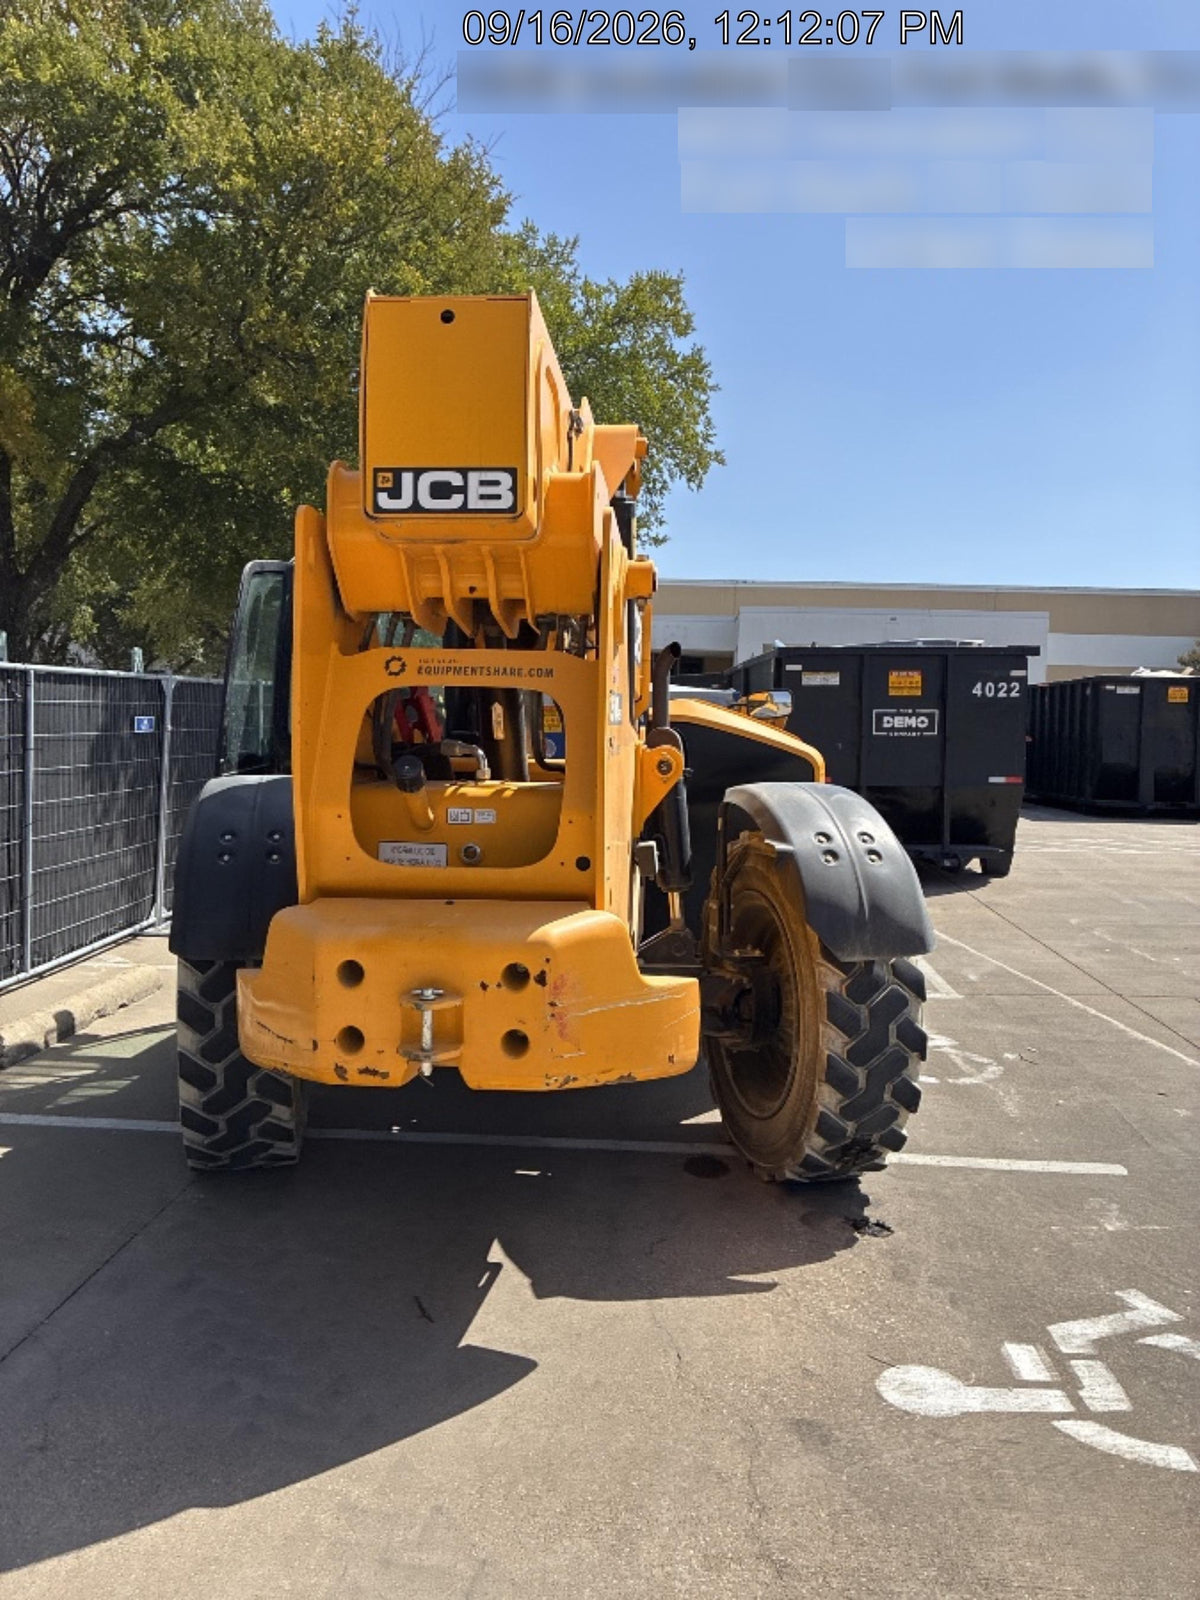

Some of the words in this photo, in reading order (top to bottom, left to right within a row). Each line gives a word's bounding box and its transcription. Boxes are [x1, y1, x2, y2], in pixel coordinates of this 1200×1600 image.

[376, 470, 515, 510] JCB
[417, 664, 554, 678] EQUIPMENTSHARE.COM
[972, 682, 1020, 698] 4022
[882, 716, 929, 728] DEMO
